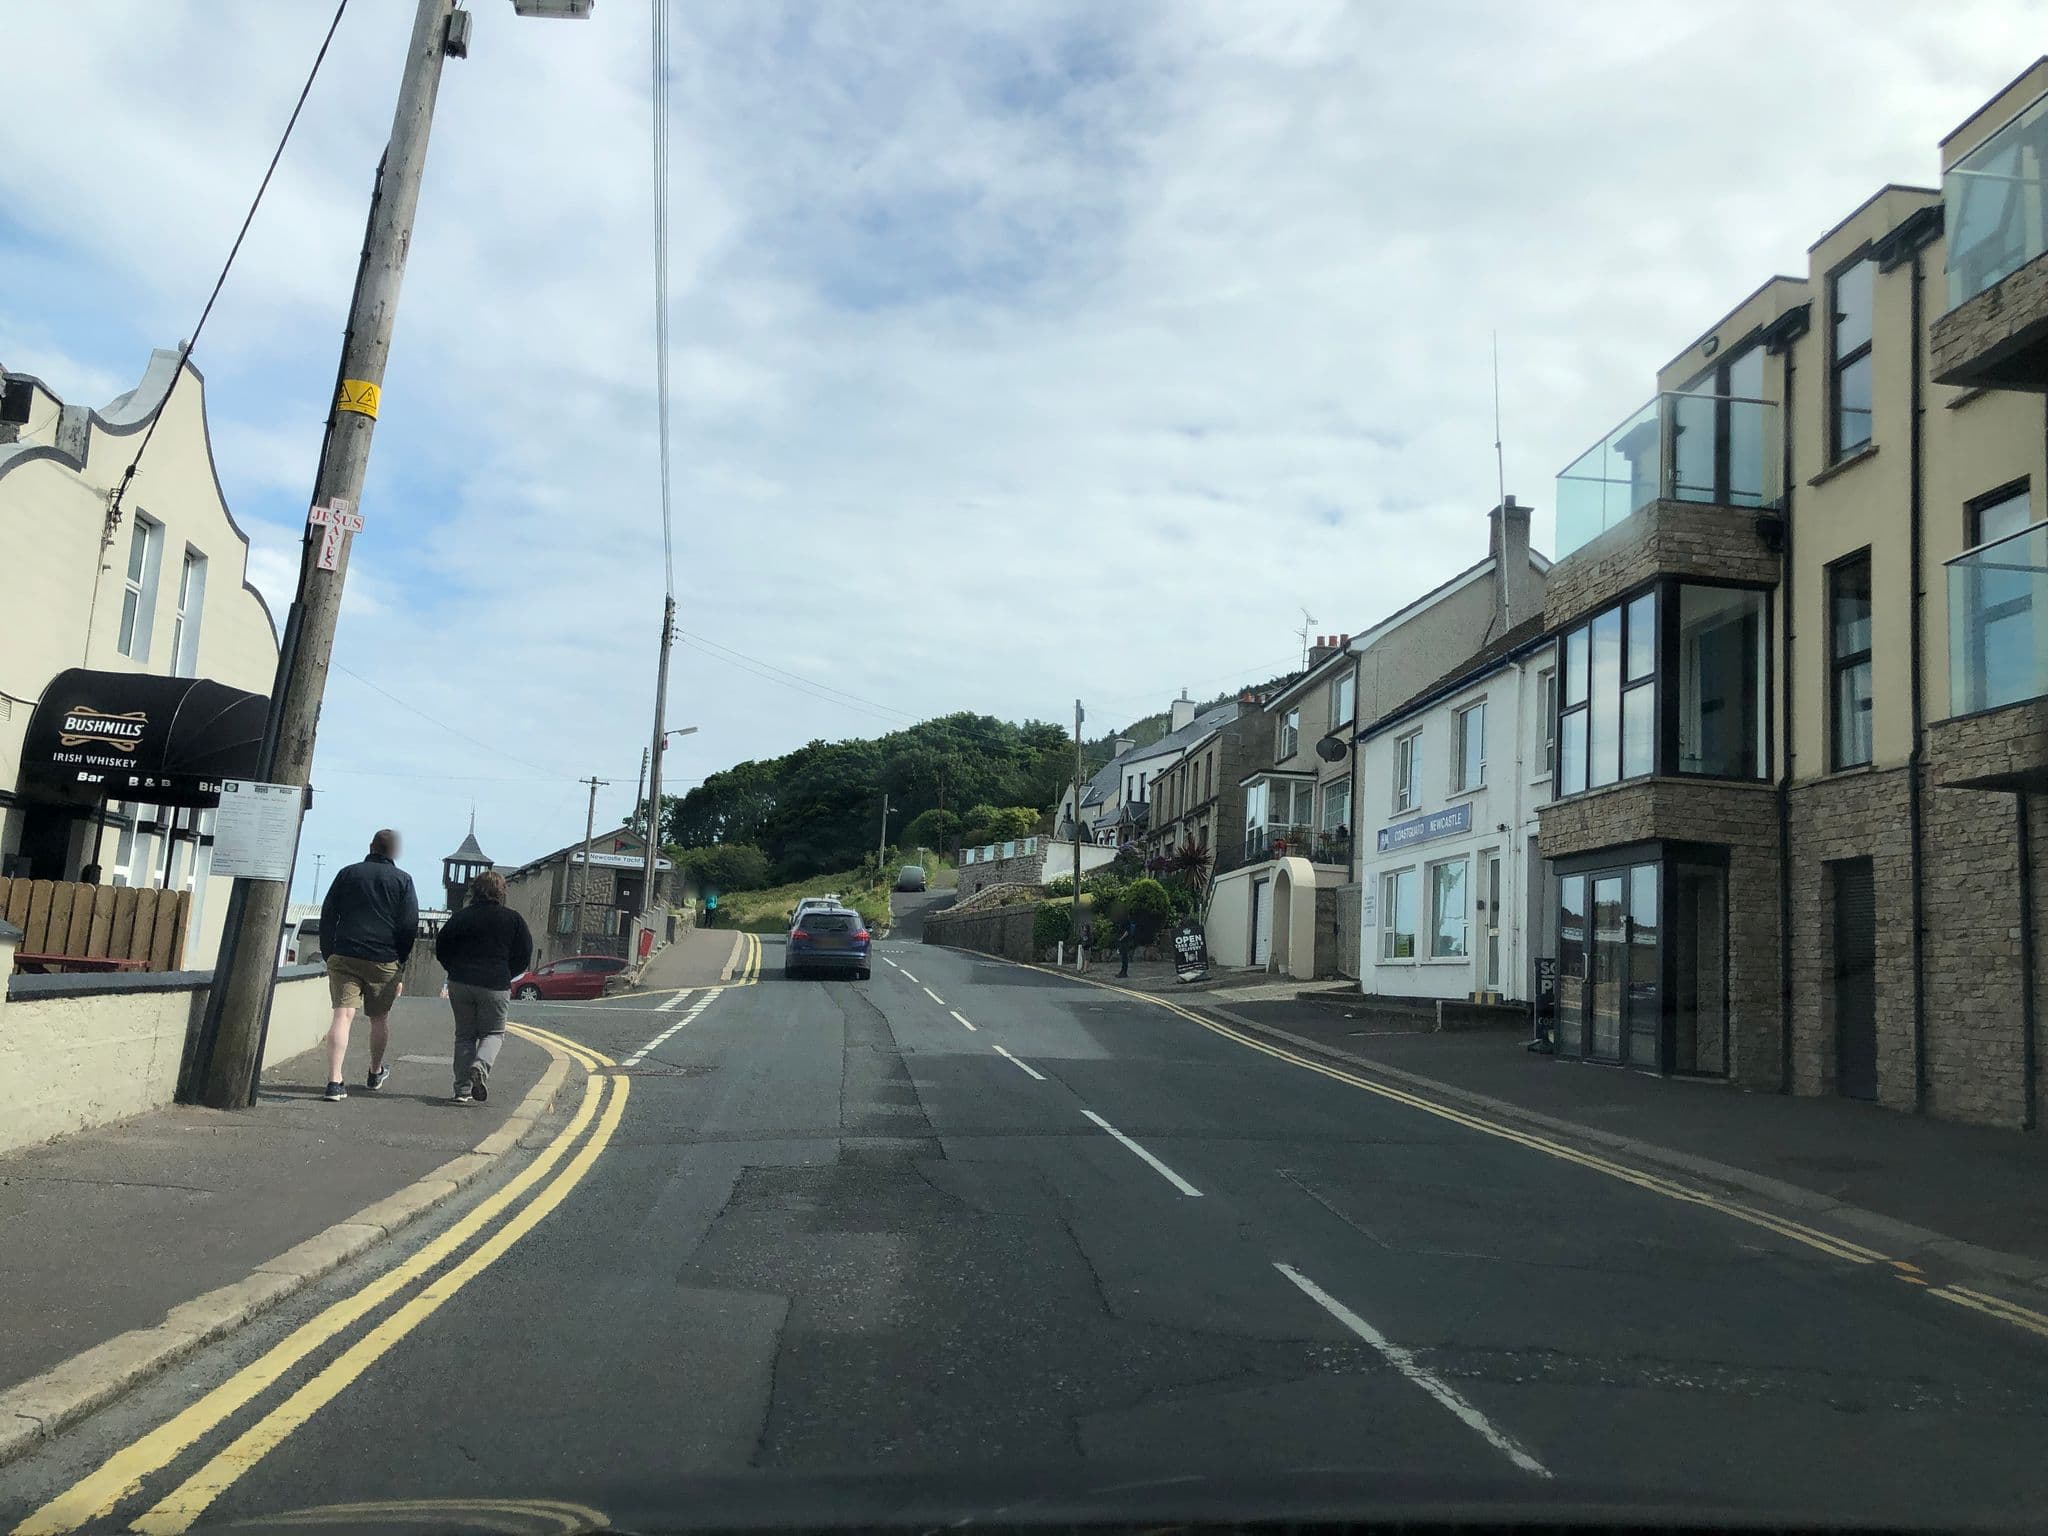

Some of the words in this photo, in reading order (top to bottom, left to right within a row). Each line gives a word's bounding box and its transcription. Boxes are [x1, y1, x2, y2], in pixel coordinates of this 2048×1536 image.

[312, 510, 362, 529] JESUS
[64, 717, 143, 737] BUSHMILLS
[53, 752, 82, 763] IRISH
[86, 755, 137, 768] WHISKEY
[77, 771, 104, 783] Bar
[128, 776, 139, 786] B
[198, 781, 221, 793] Bis
[1429, 812, 1462, 832] NEWCASTLE
[1175, 934, 1202, 945] OPEN
